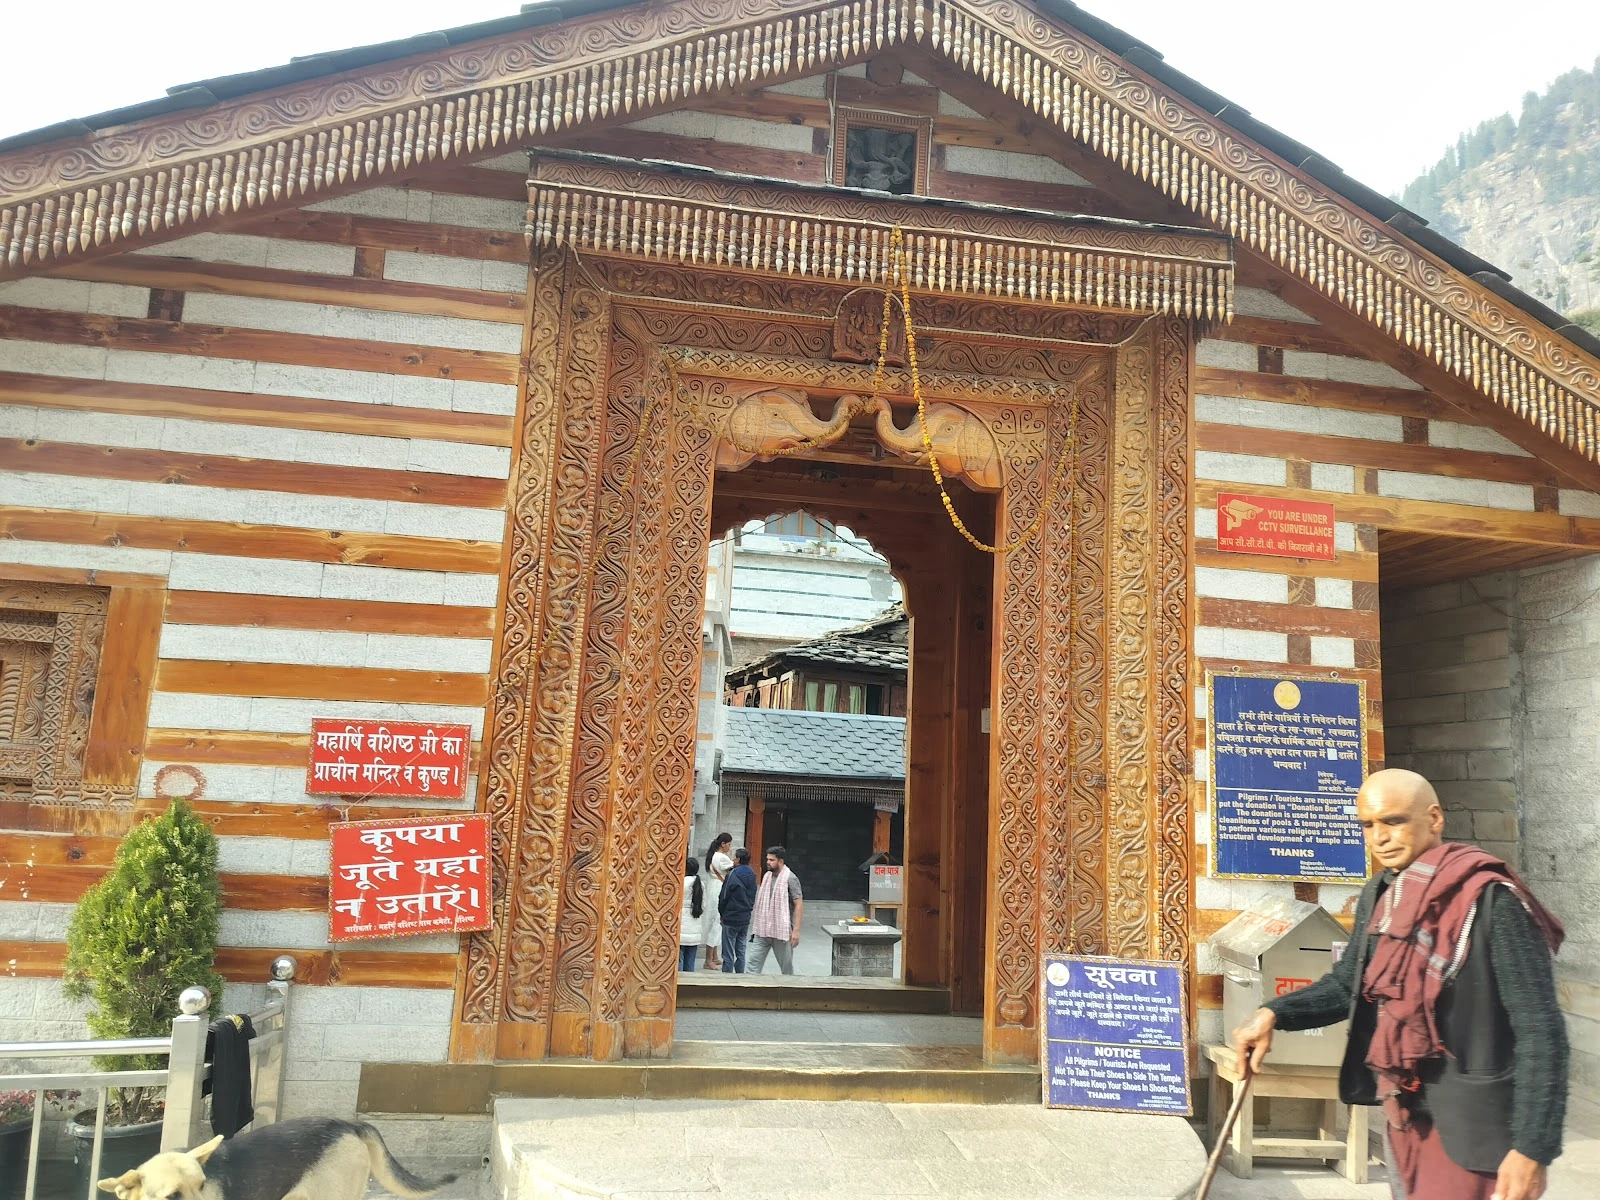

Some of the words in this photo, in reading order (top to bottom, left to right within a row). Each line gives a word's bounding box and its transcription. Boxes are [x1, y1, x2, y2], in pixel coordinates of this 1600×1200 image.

[1267, 509, 1284, 520] YOU
[1285, 511, 1301, 522] ARE
[1302, 513, 1328, 525] UNDER
[1258, 521, 1278, 532] CCTV
[1280, 524, 1333, 538] SURVEILLANCE
[1219, 537, 1234, 546] आप
[1277, 540, 1287, 551] की
[1288, 540, 1315, 553] निगरानी
[1323, 543, 1329, 556] है
[1238, 710, 1256, 720] सभी
[1257, 711, 1273, 721] तीर्थ
[1302, 713, 1311, 723] से
[1311, 714, 1337, 725] निवेदन
[1337, 715, 1357, 726] किया
[1216, 722, 1236, 730] जाता
[1236, 720, 1244, 732] है
[1244, 721, 1256, 731] कि
[1257, 722, 1279, 734] मन्दिर
[1279, 723, 1287, 733] के
[368, 727, 416, 753] वशिष्ठ
[419, 729, 438, 755] जी
[442, 737, 463, 756] का
[1216, 732, 1245, 743] पवित्रता
[1252, 734, 1273, 745] मन्दिर
[1273, 734, 1281, 745] के
[1281, 735, 1305, 746] धार्मिक
[1325, 737, 1336, 747] को
[1336, 740, 1359, 749] सम्पन्न
[1216, 743, 1234, 754] करने
[1234, 744, 1248, 757] हेतु
[1248, 747, 1263, 755] दान
[1264, 748, 1287, 758] कृपया
[1287, 749, 1302, 757] दान
[1303, 750, 1318, 758] पात्र
[1319, 748, 1327, 759] में
[314, 756, 359, 781] प्राचीन
[362, 757, 401, 787] मन्दिर
[403, 766, 415, 784] व
[1273, 760, 1302, 770] धन्यवाद
[1238, 793, 1268, 802] Pilgrims
[1274, 794, 1302, 803] Tourists
[1317, 797, 1352, 806] requested
[1236, 808, 1250, 816] The
[1251, 809, 1282, 817] donation
[1219, 816, 1260, 825] cleanliness
[1272, 819, 1292, 827] pools
[1302, 820, 1327, 828] temple
[1329, 822, 1361, 830] complex,
[1229, 825, 1257, 833] perform
[1259, 826, 1286, 834] various
[1288, 828, 1320, 837] religious
[1322, 829, 1342, 837] ritual
[1344, 829, 1350, 837] &
[360, 823, 465, 853] कृपया
[1220, 833, 1254, 841] structural
[1257, 834, 1303, 843] development
[1316, 837, 1341, 845] temple
[1269, 848, 1315, 857] THANKS
[339, 856, 404, 890] जूते
[414, 849, 484, 878] यहां
[335, 898, 366, 918] न
[1083, 965, 1158, 989] सूचना
[1095, 1046, 1141, 1059] NOTICE
[1065, 1056, 1073, 1065] All
[1074, 1057, 1098, 1067] Pilgrims
[1103, 1059, 1127, 1069] Tourists
[1127, 1061, 1138, 1069] Are
[1138, 1061, 1171, 1072] Requested
[1055, 1066, 1066, 1075] Not
[1066, 1067, 1075, 1075] To
[1075, 1068, 1089, 1077] Take
[1090, 1069, 1106, 1078] Their
[1106, 1070, 1125, 1079] Shoes
[1126, 1071, 1132, 1080] In
[1132, 1072, 1147, 1080] Side
[1147, 1072, 1159, 1081] The
[1159, 1073, 1181, 1084] Temple
[1070, 1078, 1090, 1088] Please
[1091, 1080, 1106, 1090] Keep
[1107, 1081, 1122, 1090] Your
[1122, 1082, 1141, 1092] Shoes
[1142, 1083, 1148, 1092] In
[1149, 1084, 1168, 1093] Shoes
[1168, 1085, 1185, 1094] Place
[1087, 1091, 1121, 1100] THANKS
